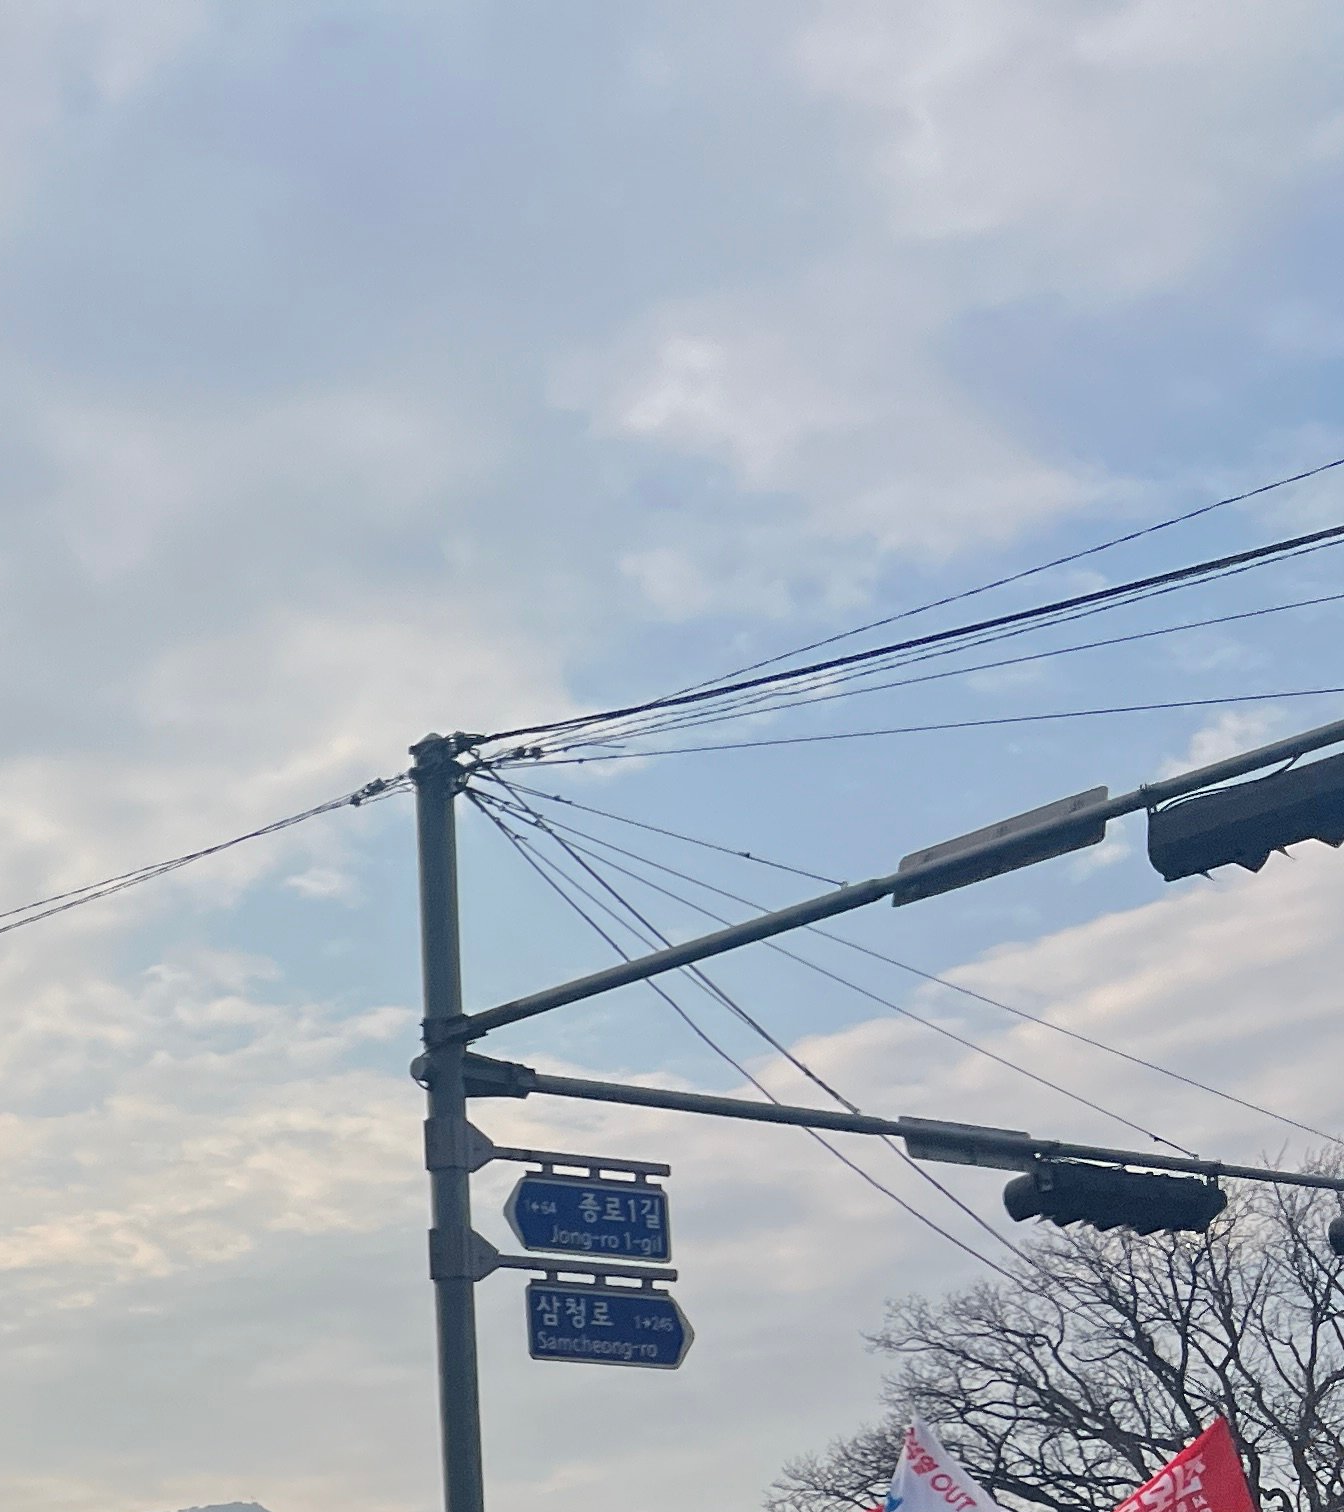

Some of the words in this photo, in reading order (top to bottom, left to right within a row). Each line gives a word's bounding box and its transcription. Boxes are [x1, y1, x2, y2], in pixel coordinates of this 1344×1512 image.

[578, 1193, 661, 1229] 종로1길
[550, 1225, 618, 1252] Jong-ro
[624, 1231, 663, 1255] 1-gil
[536, 1295, 614, 1329] 삼청로
[537, 1331, 658, 1359] Samcheong-ro
[930, 1473, 976, 1511] OUT
